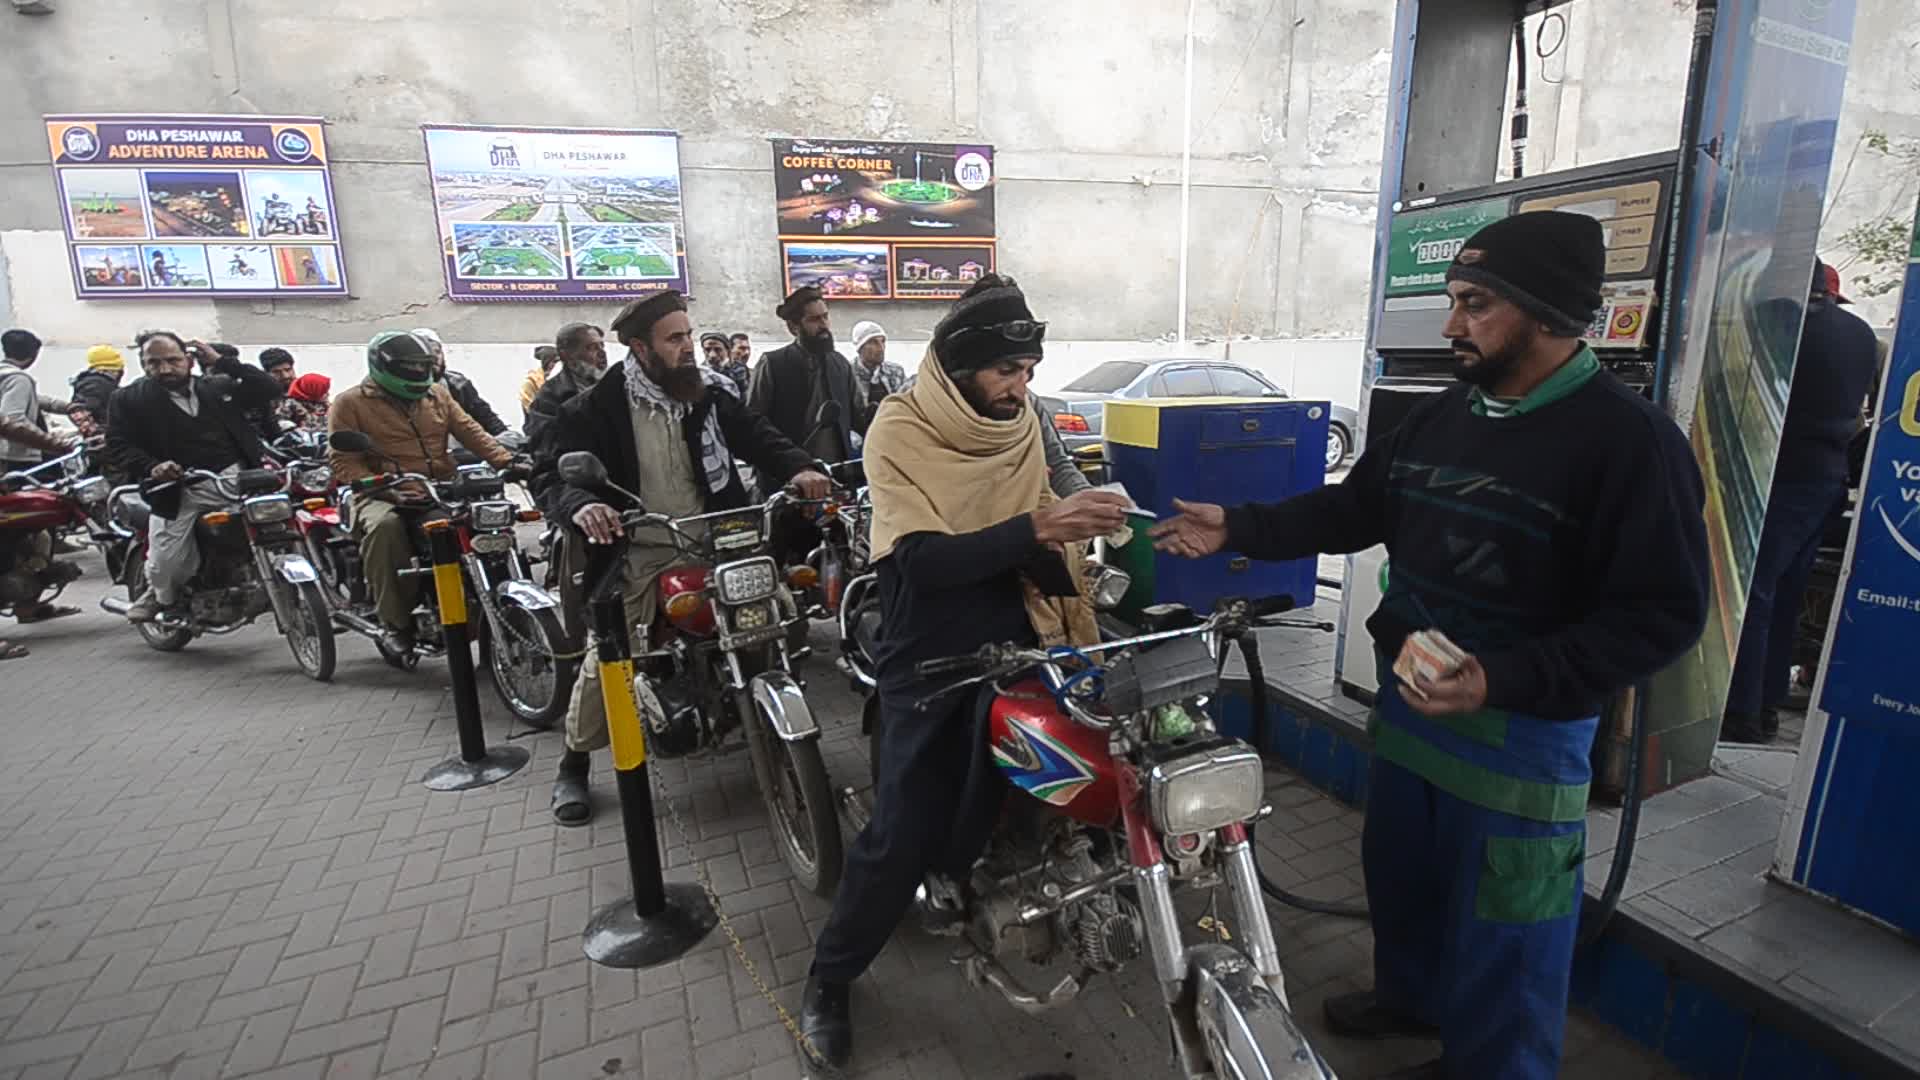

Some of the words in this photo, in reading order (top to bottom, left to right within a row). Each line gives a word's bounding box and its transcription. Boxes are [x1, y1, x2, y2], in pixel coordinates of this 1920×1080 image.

[126, 129, 158, 142] DHA
[161, 130, 244, 142] PESHAWAR
[109, 144, 208, 158] ADVENTURE
[211, 146, 269, 159] ARENA
[543, 151, 566, 161] DHA
[568, 151, 627, 161] PESHAWAR
[783, 156, 834, 169] COFFEE
[837, 158, 892, 170] CORNER
[470, 282, 503, 291] SECTOR
[518, 282, 559, 291] COMPLEX
[585, 282, 617, 291] SECTOR
[631, 282, 669, 290] COMPLEX
[1872, 693, 1905, 712] Every
